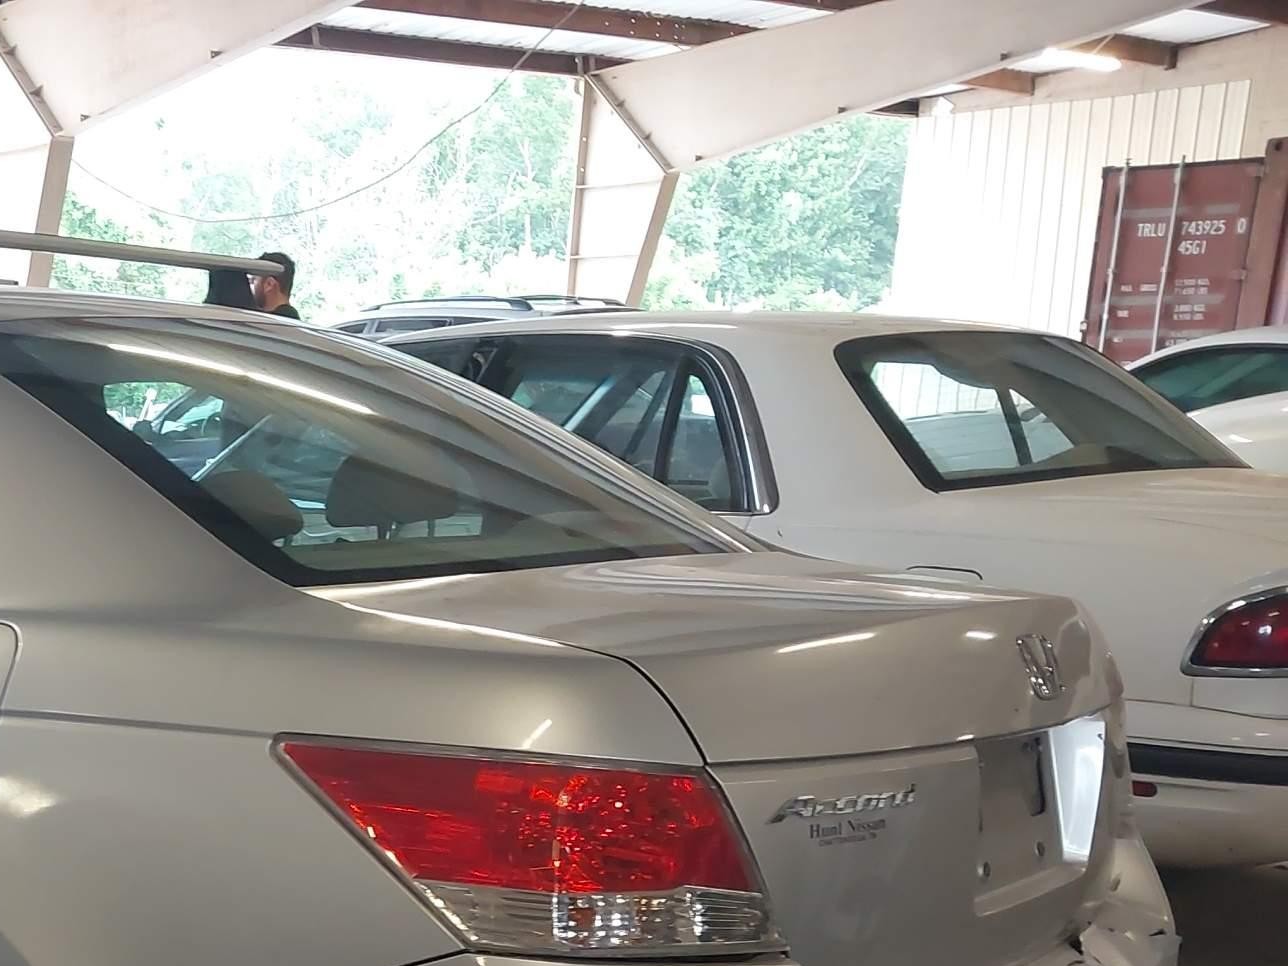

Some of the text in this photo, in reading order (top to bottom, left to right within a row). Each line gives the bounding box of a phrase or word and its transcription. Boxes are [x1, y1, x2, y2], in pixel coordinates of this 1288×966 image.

[1137, 223, 1166, 237] TRLU
[1181, 220, 1226, 235] 743925
[1177, 240, 1207, 255] 45G1
